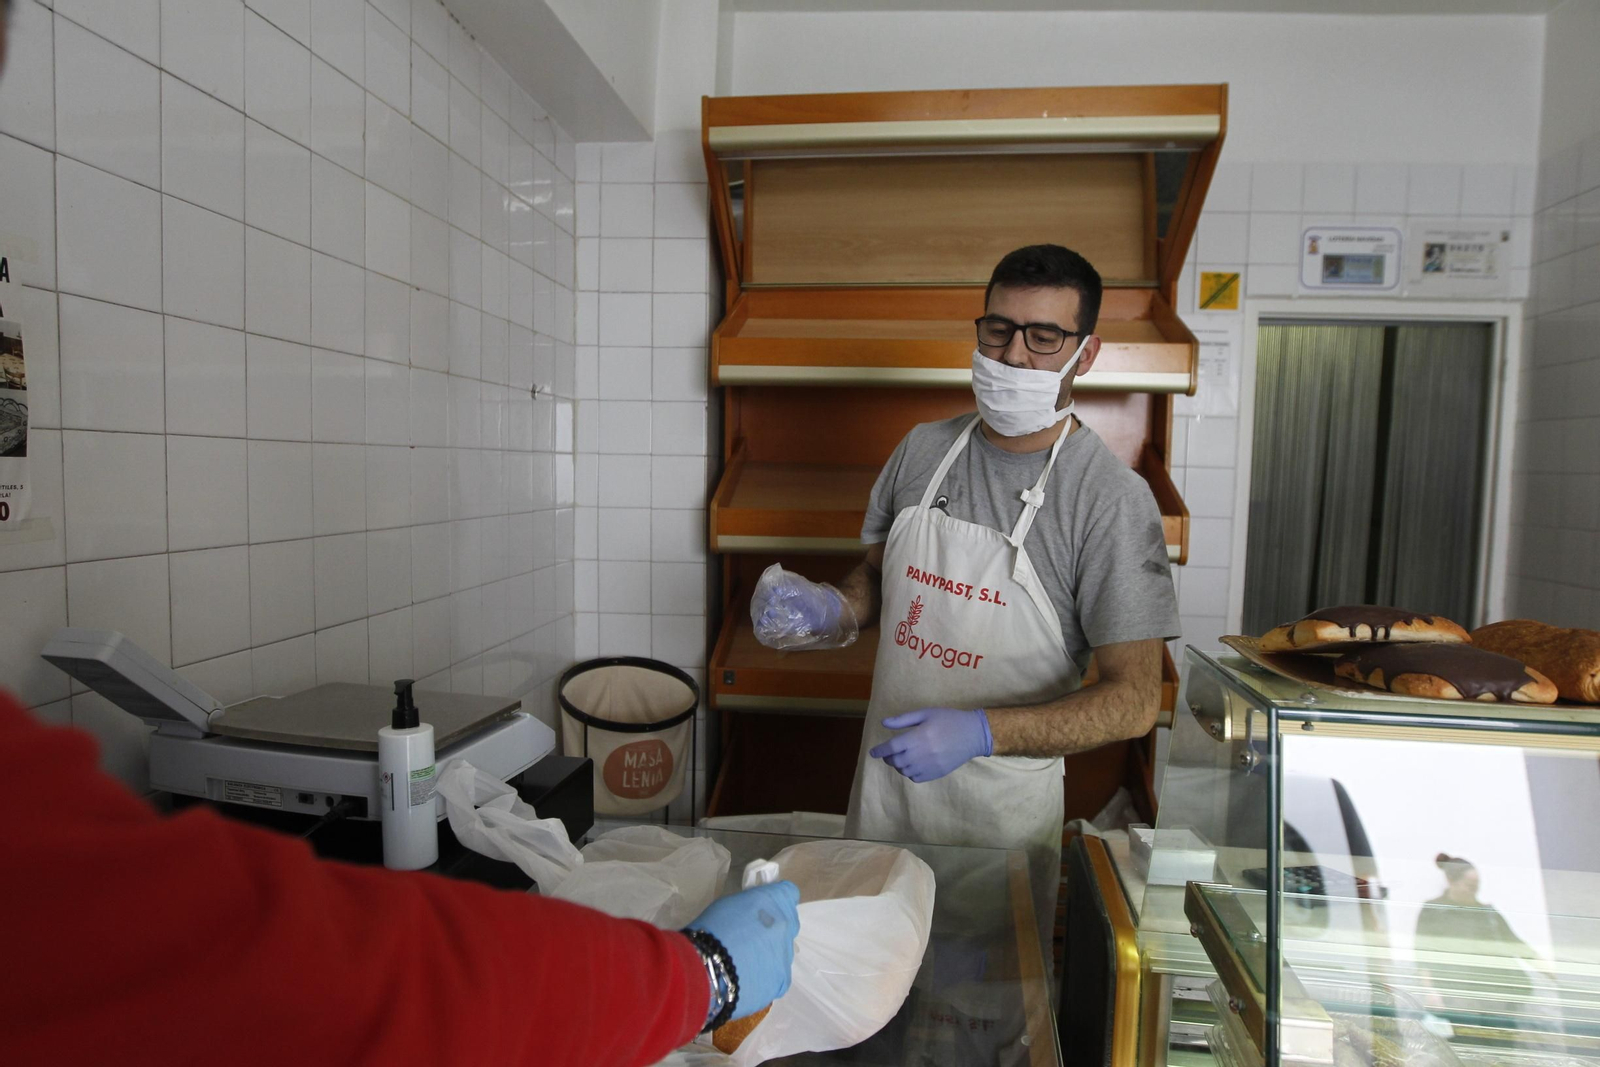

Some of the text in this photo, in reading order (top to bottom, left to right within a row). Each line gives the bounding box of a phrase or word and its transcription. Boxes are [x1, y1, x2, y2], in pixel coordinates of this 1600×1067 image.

[0, 256, 10, 283] A
[906, 565, 1007, 607] PANYPAST, S.L.
[894, 621, 984, 669] Bayogar
[624, 747, 663, 769] MASA
